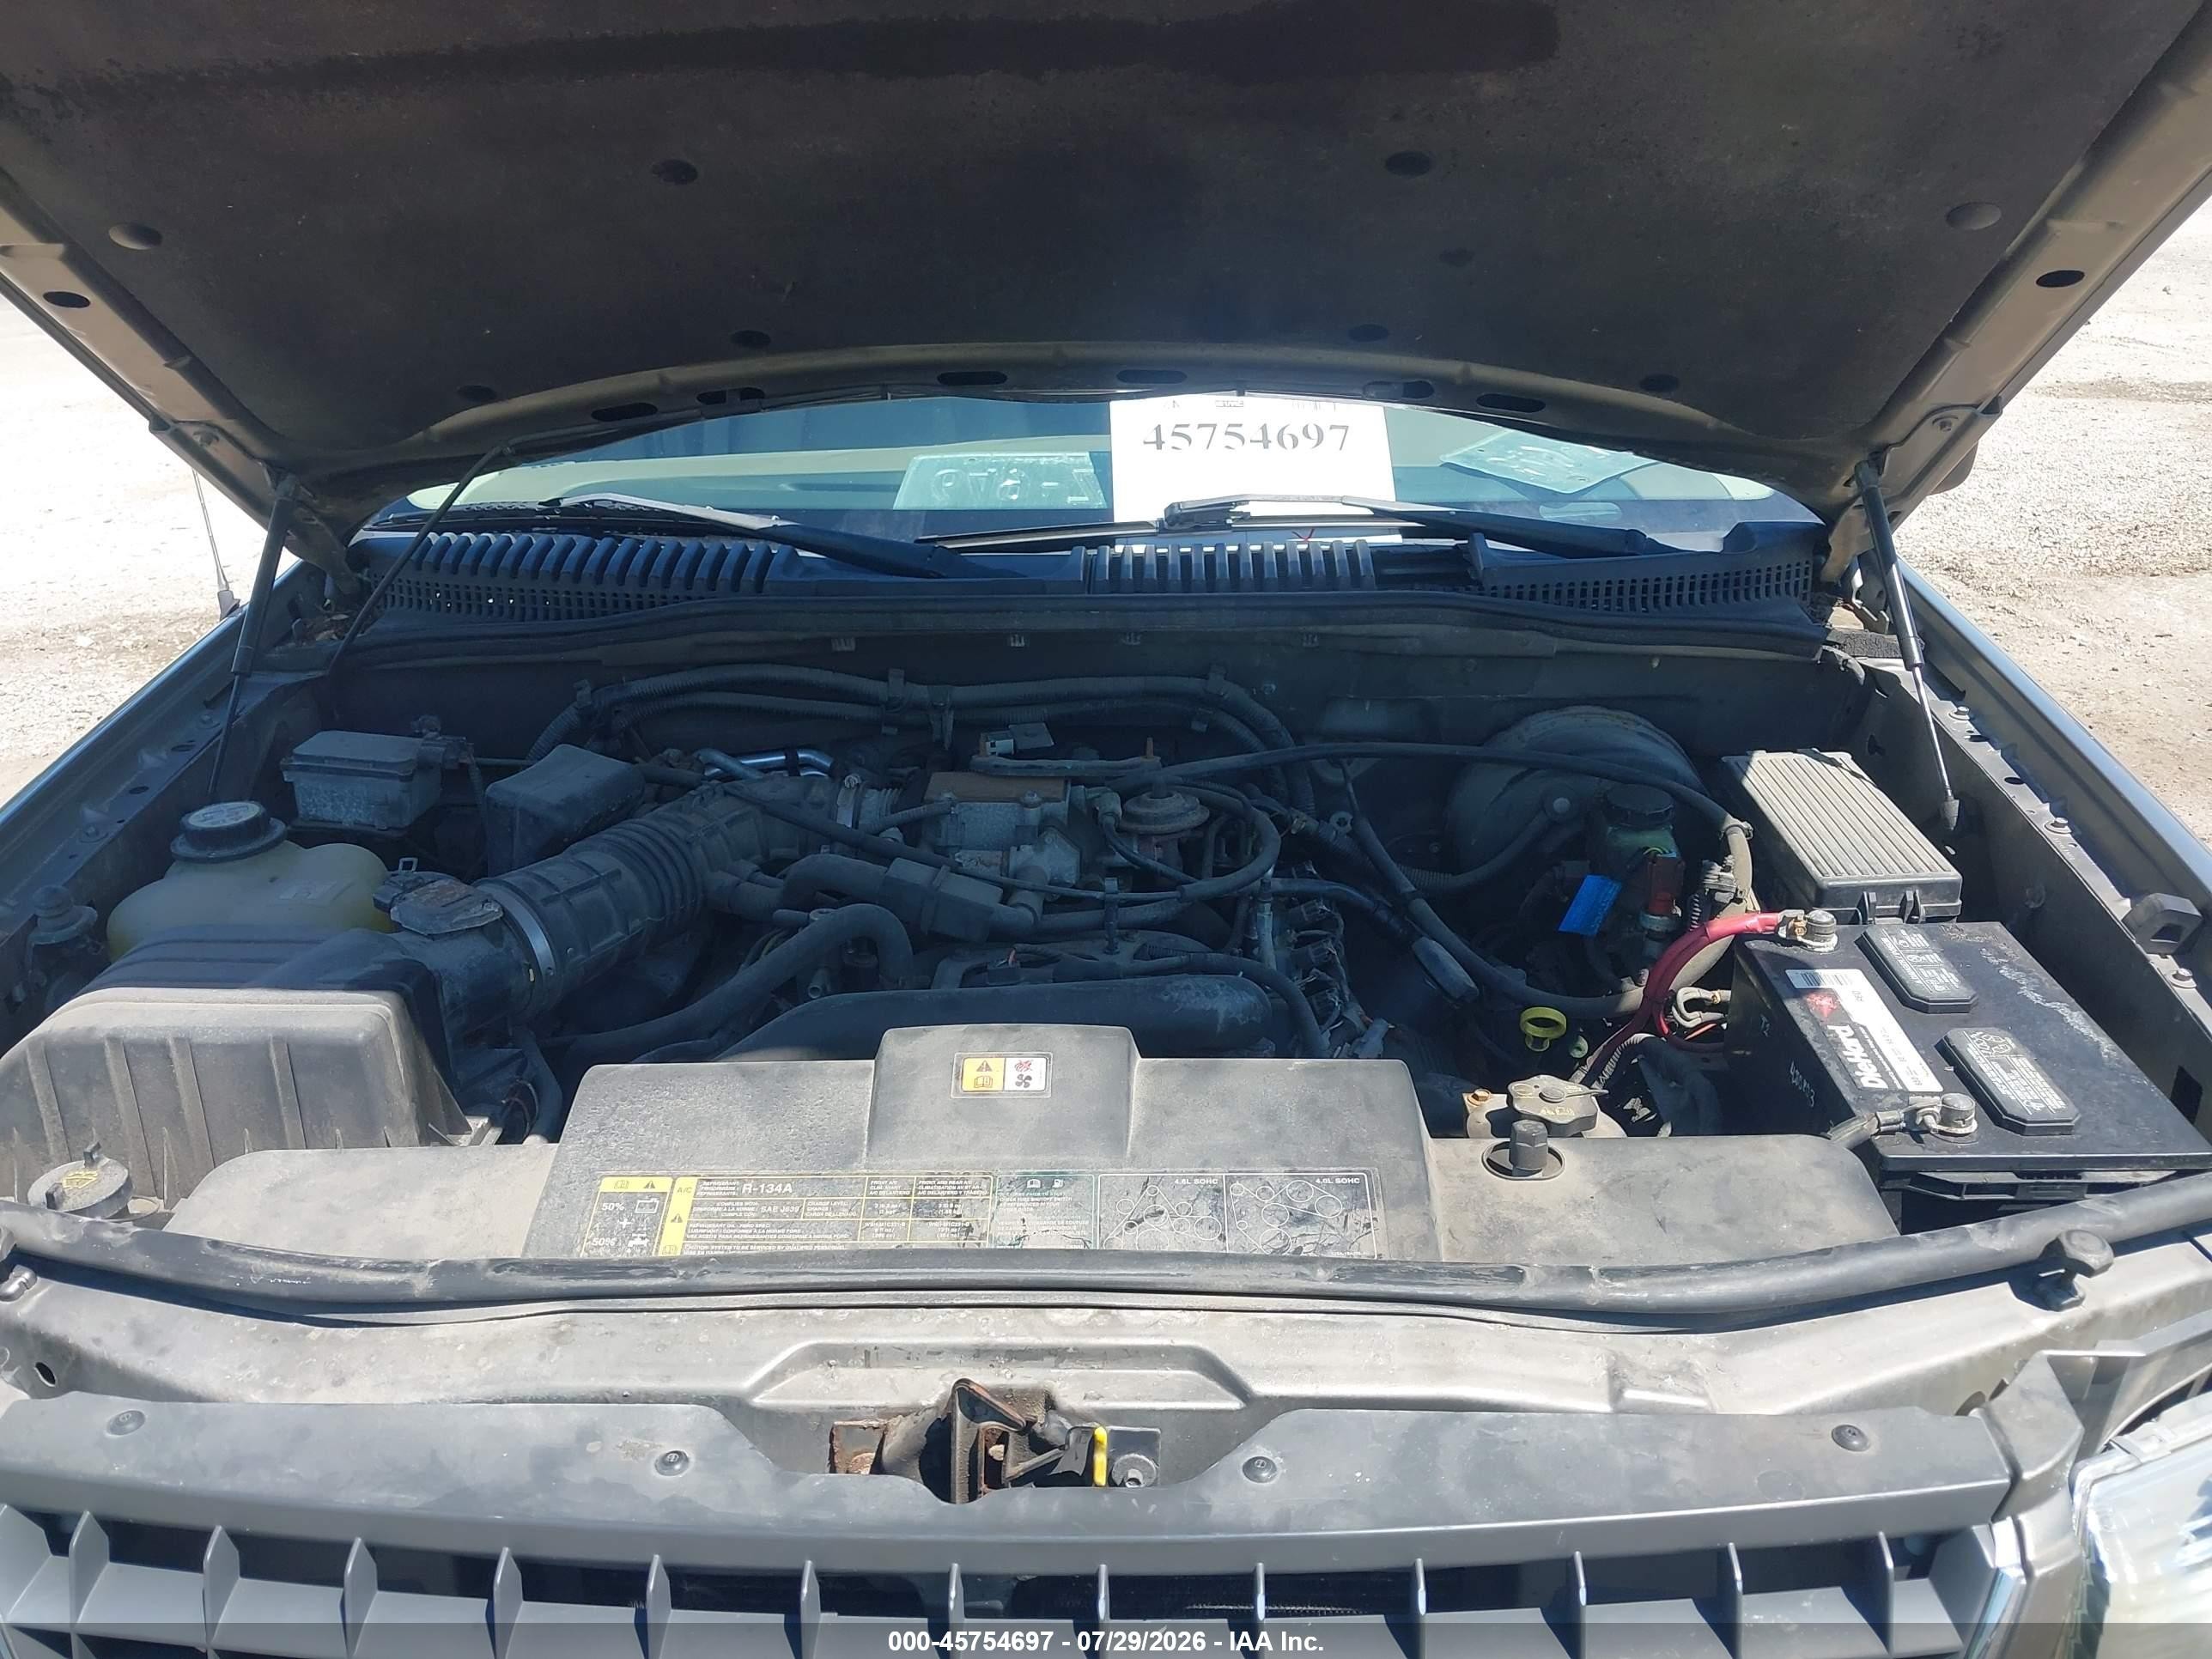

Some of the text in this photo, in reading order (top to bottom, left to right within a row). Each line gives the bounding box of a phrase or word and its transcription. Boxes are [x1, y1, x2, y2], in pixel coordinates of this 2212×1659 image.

[1142, 422, 1351, 451] 45754697
[1826, 1024, 1888, 1089] DieHard
[741, 1183, 793, 1194] R-134A
[601, 1202, 625, 1211] 50%
[592, 1237, 617, 1247] 50%
